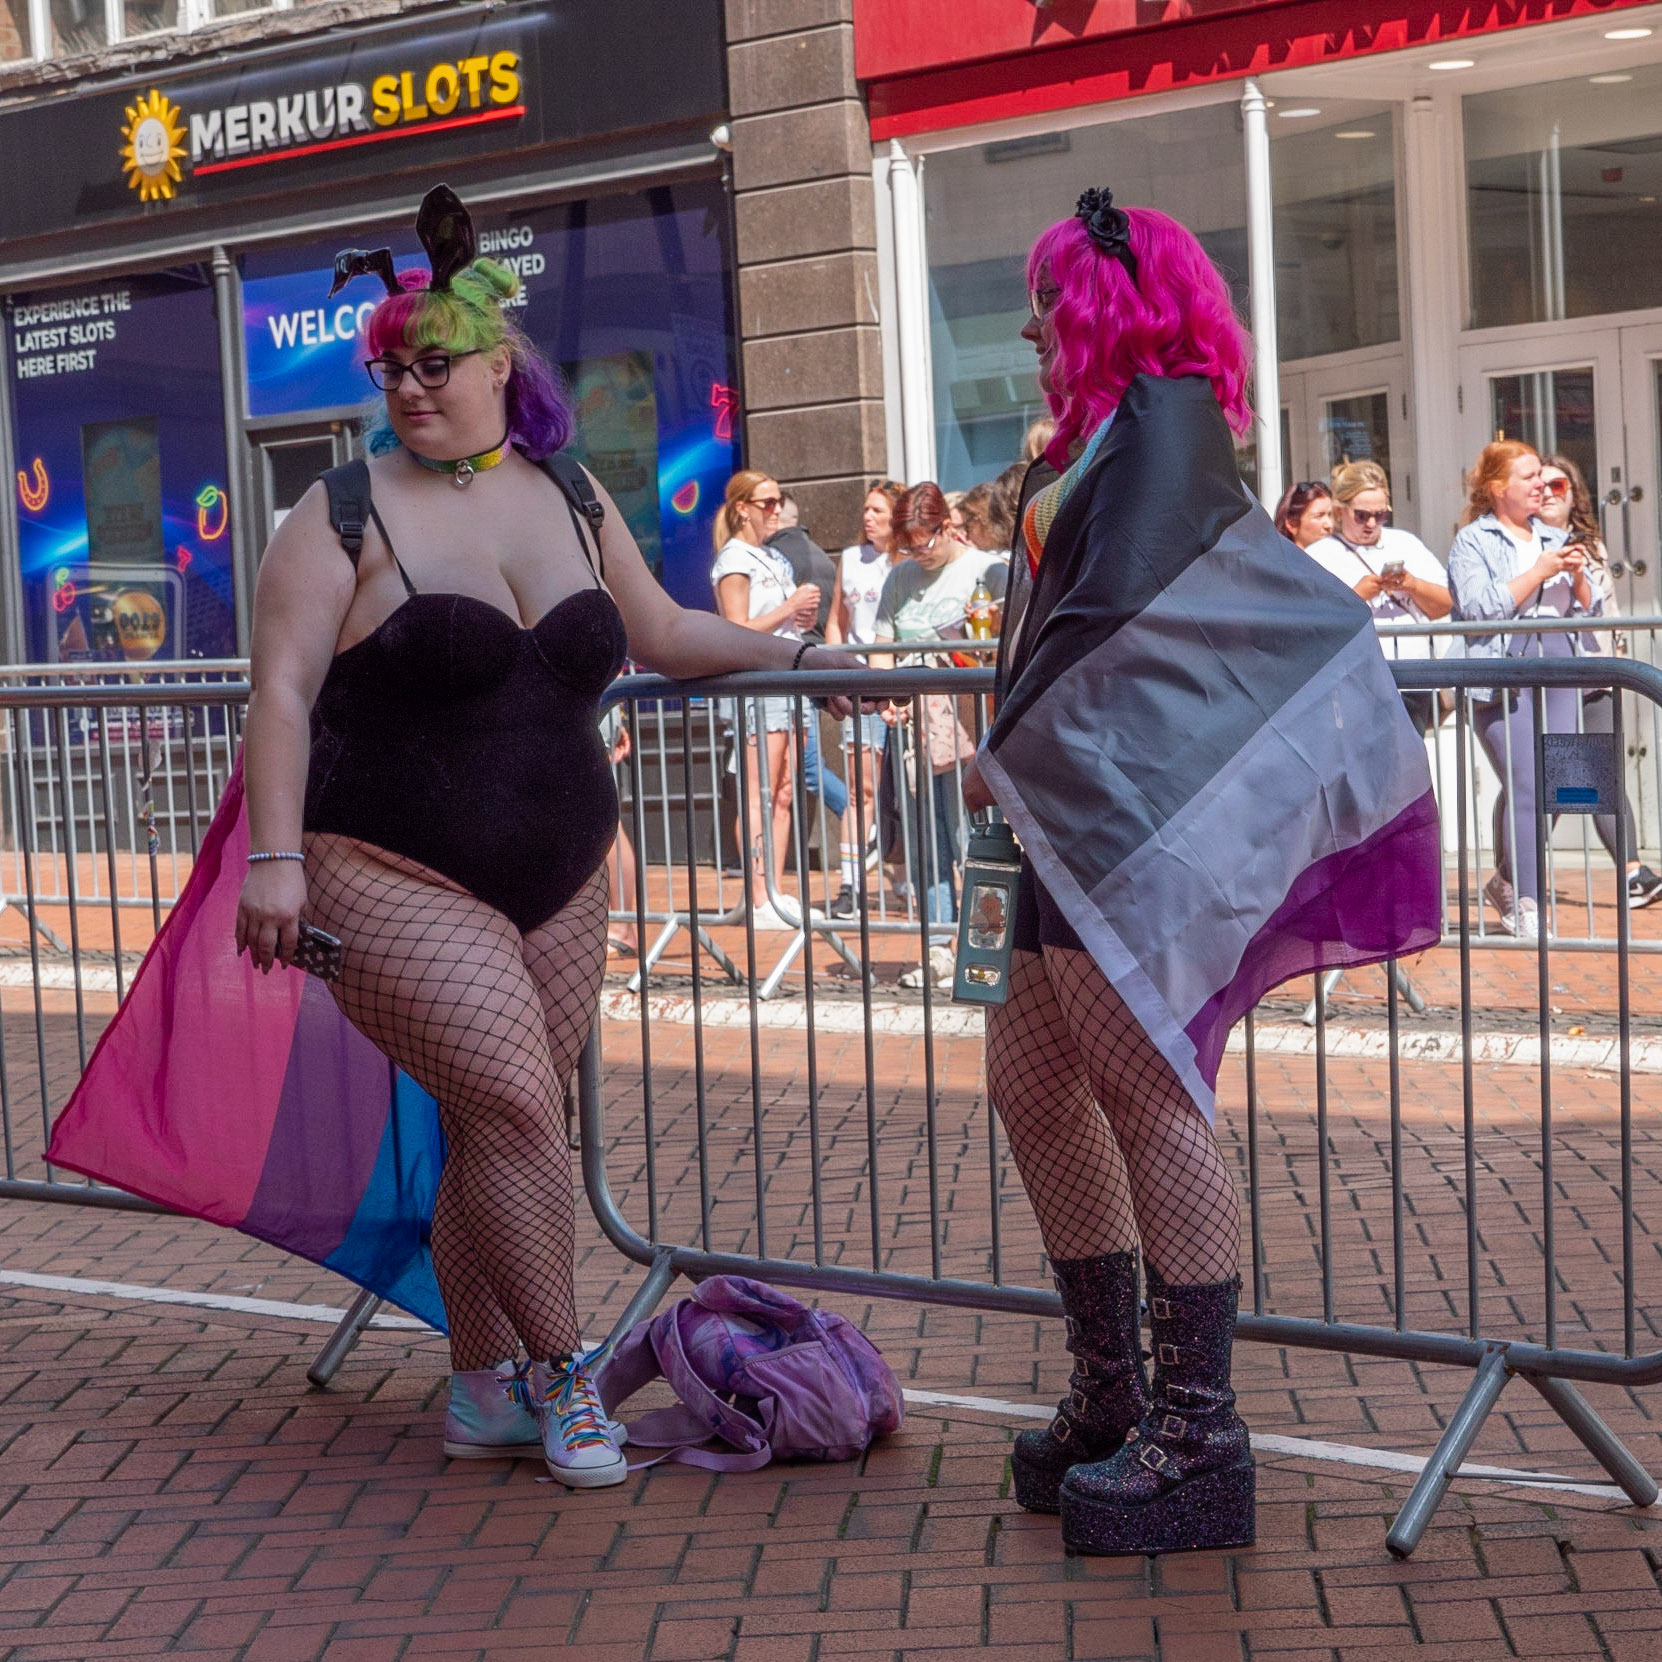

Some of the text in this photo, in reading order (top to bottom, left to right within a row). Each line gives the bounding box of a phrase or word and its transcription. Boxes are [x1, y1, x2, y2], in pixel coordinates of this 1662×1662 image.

[190, 50, 521, 162] MERKUR SLOTS
[479, 225, 534, 254] BINGO
[503, 253, 546, 277] AYED
[14, 290, 132, 327] EXPERIENCE THE
[15, 320, 117, 354] LATEST SLOTS
[267, 302, 377, 350] WELCO
[17, 349, 97, 380] HERE FIRST
